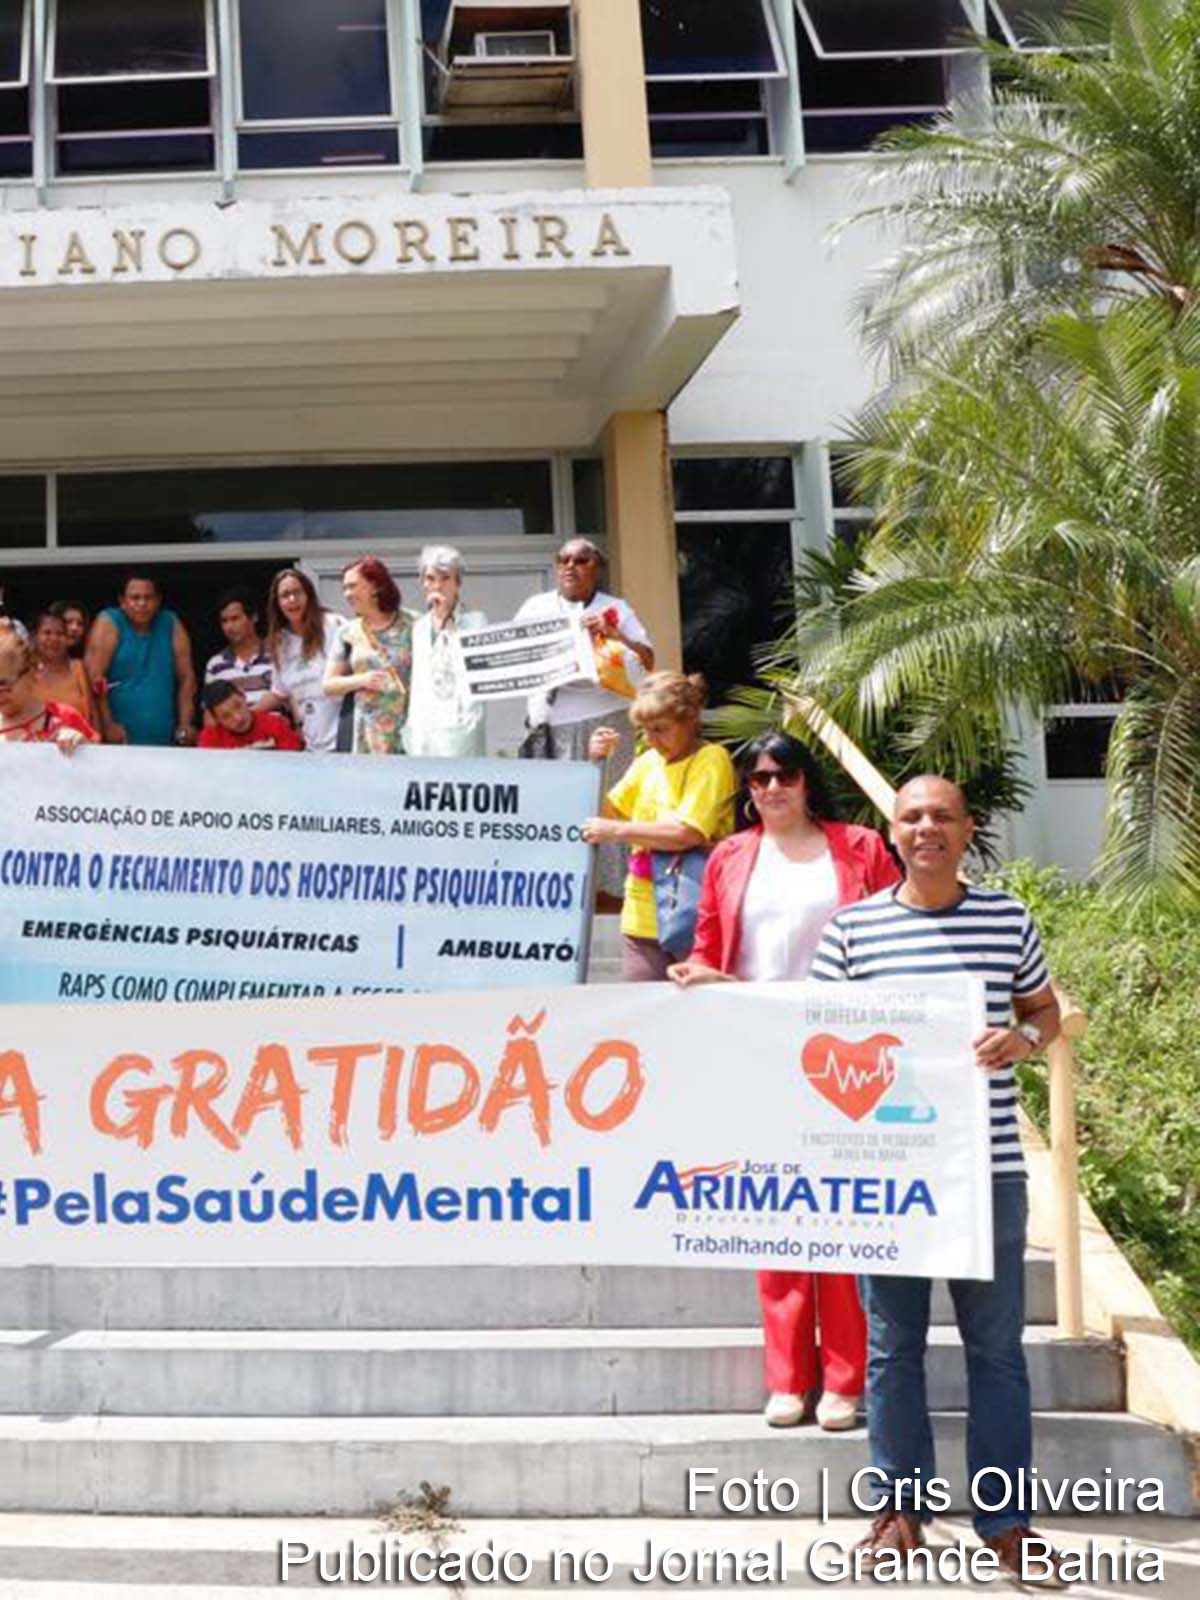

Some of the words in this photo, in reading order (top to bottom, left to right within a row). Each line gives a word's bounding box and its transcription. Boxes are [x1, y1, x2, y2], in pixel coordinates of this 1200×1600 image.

[270, 213, 631, 265] MOREIRA
[403, 781, 519, 814] AFATOM
[34, 805, 146, 830] ASSOCIAÇÃO
[151, 810, 174, 826] DE
[179, 810, 233, 829] APOIO
[238, 814, 273, 831] AOS
[278, 814, 385, 837] FAMILIARES,
[390, 819, 459, 838] AMIGOS
[464, 822, 474, 838] E
[480, 823, 563, 842] PESSOAS
[0, 850, 81, 888] CONTRA
[88, 853, 104, 888] O
[108, 854, 244, 895] FECHAMENTO
[250, 861, 292, 897] DOS
[297, 862, 407, 902] HOSPITAIS
[413, 859, 574, 909] PSIQUIÁTRICOS
[185, 925, 360, 953] PSIQUIÁTRICAS
[58, 972, 105, 999] RAPS
[111, 975, 168, 1002] COMO
[89, 1009, 645, 1152] GRATIDÃO
[633, 1160, 937, 1216] ARIMATEIA
[672, 1233, 803, 1256] Trabalhando
[808, 1241, 843, 1262] por
